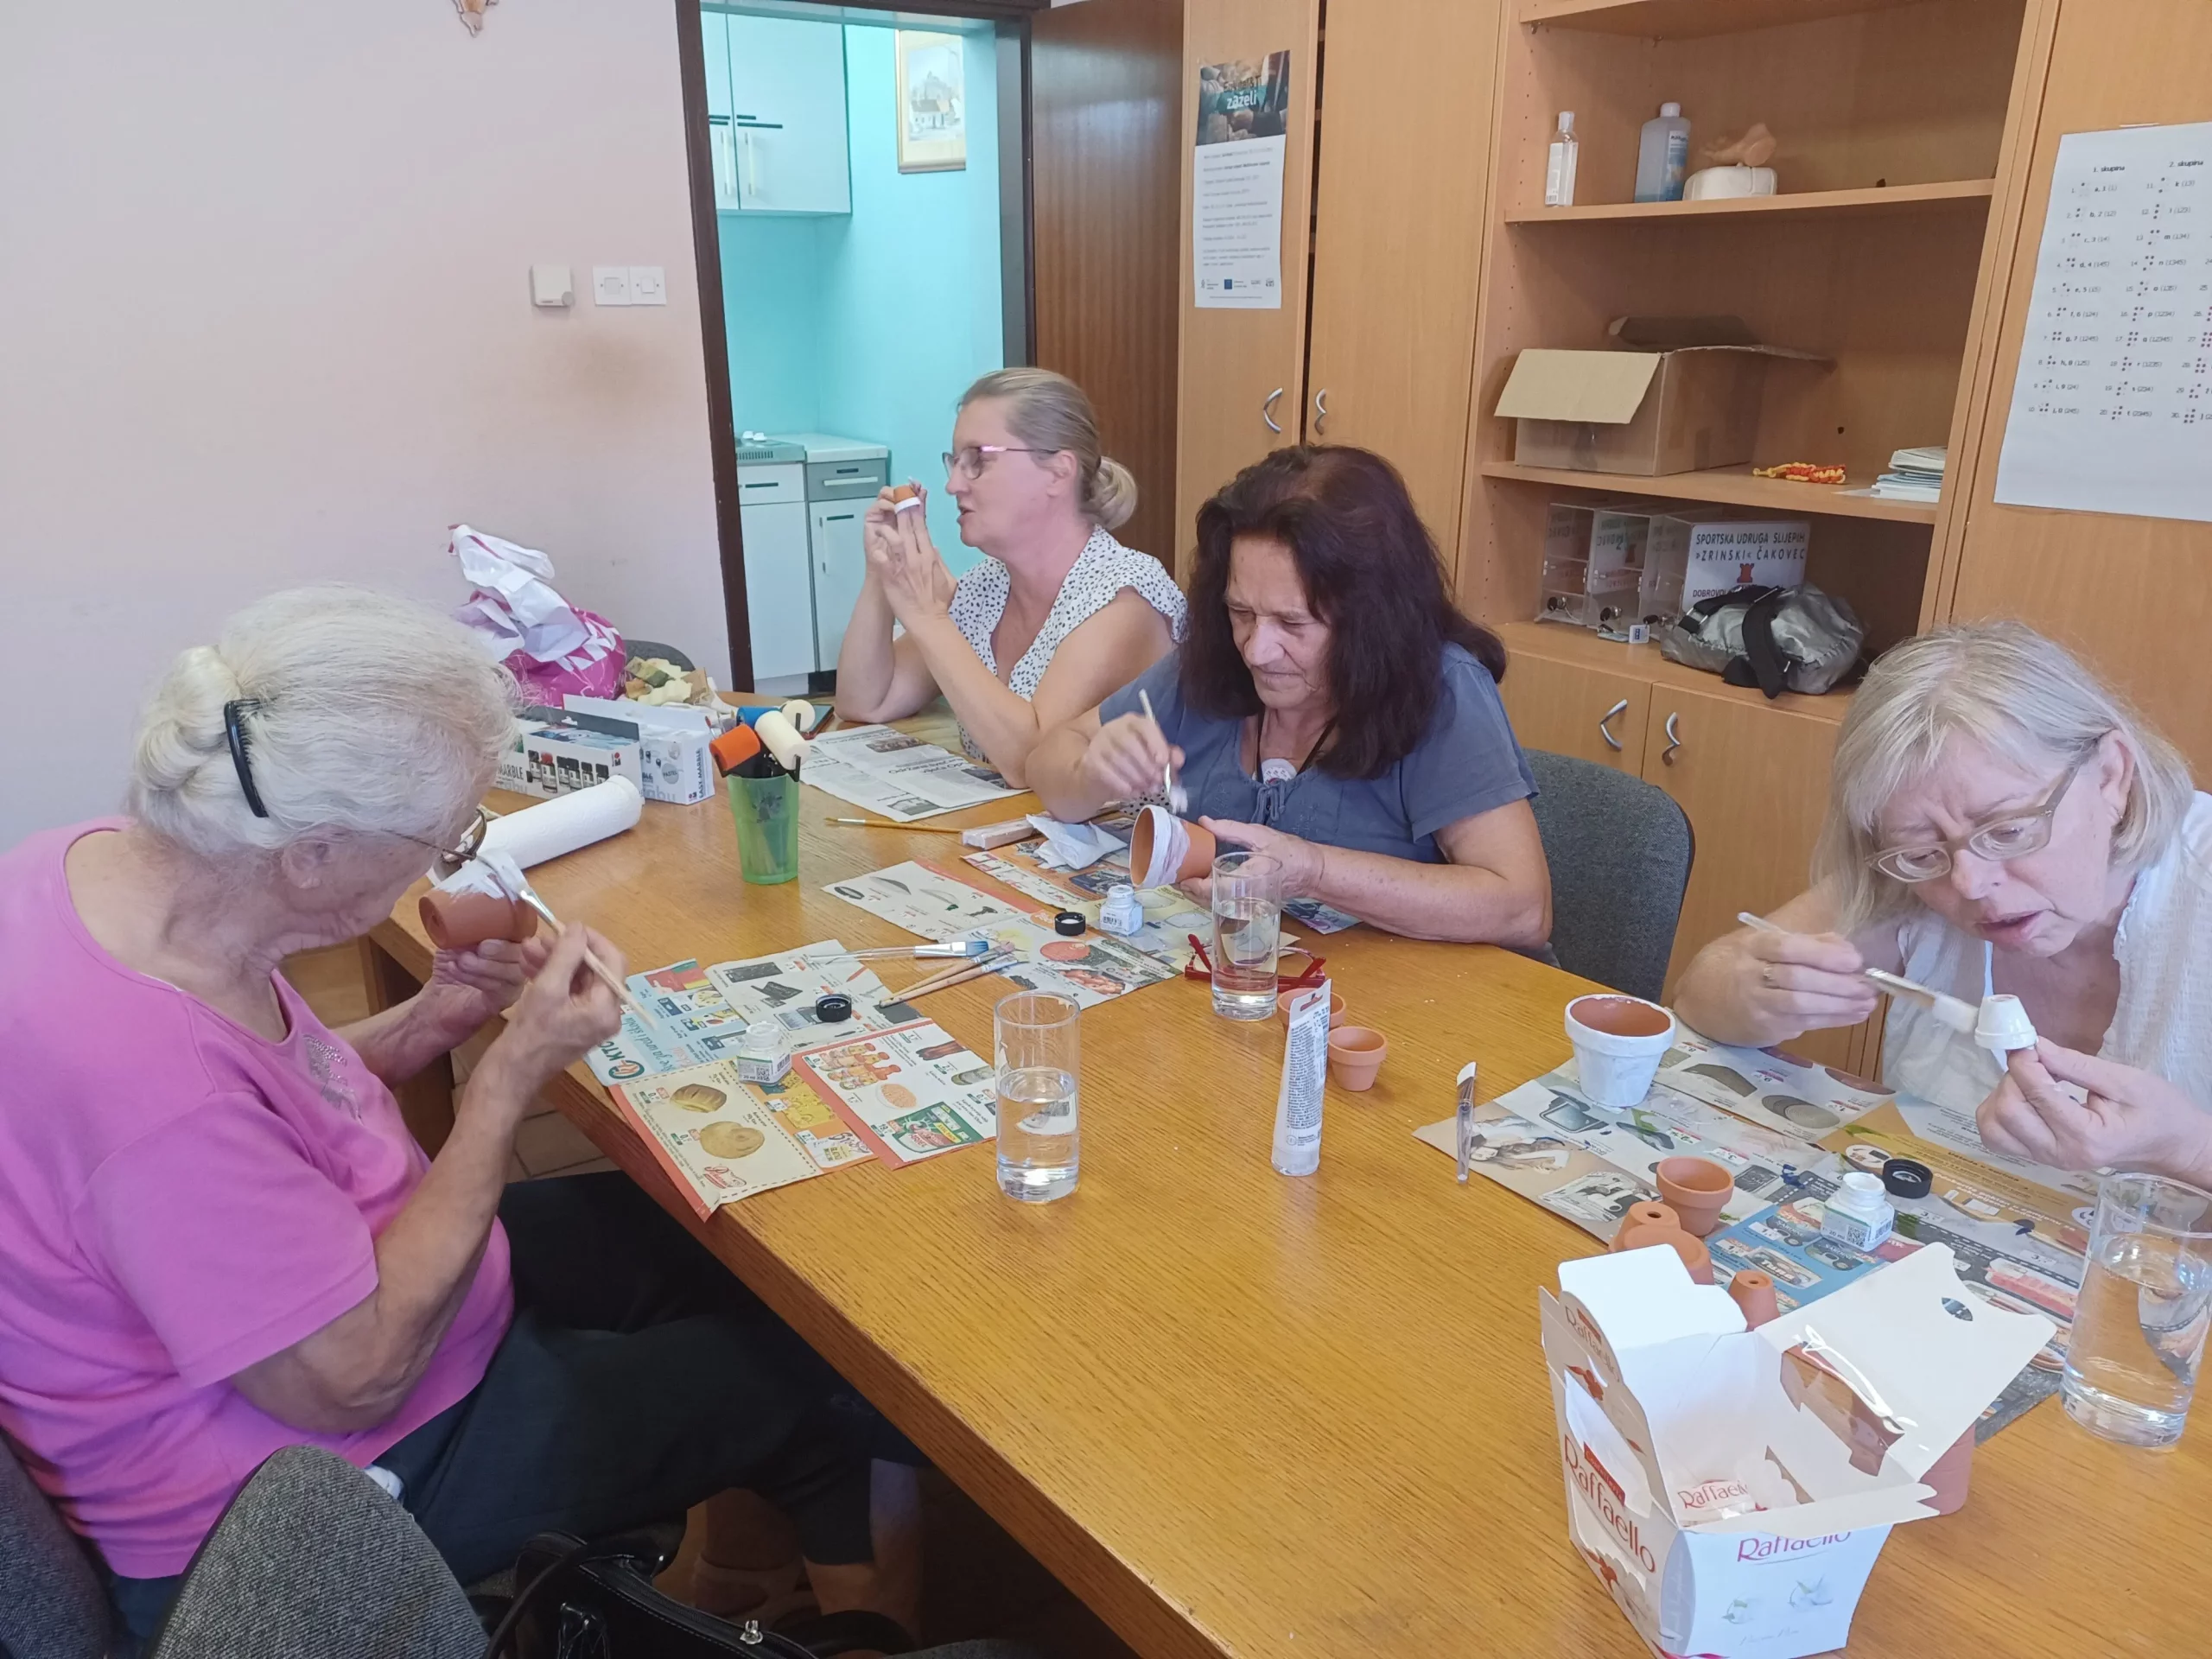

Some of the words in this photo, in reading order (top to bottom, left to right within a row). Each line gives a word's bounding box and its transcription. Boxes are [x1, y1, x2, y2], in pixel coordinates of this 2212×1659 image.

[1227, 90, 1257, 110] zaželi
[1695, 533, 1734, 545] SPORTSKA
[1736, 532, 1769, 544] UDRUGA
[1773, 532, 1805, 543] SLIJEPIH
[1757, 545, 1805, 561] ČAKOVEC
[695, 748, 703, 779] MARBLE
[598, 1040, 626, 1061] KTC
[642, 1038, 658, 1052] ured
[652, 1050, 670, 1063] za
[1776, 1218, 1804, 1237] SARDINE
[1761, 1259, 1795, 1280] Tuna
[1565, 1304, 1620, 1382] Raffaello
[1564, 1433, 1656, 1573] Raffaello
